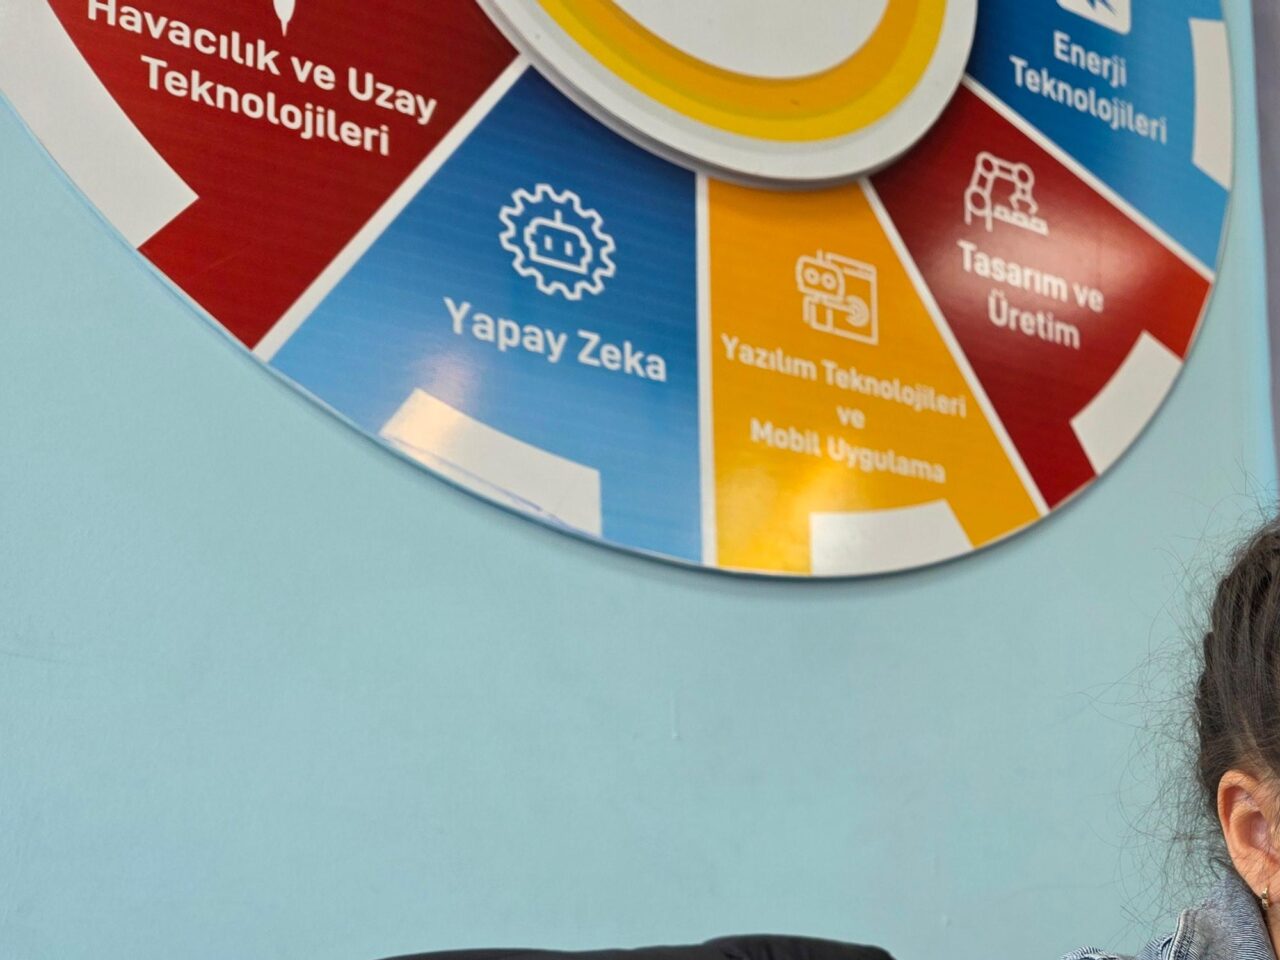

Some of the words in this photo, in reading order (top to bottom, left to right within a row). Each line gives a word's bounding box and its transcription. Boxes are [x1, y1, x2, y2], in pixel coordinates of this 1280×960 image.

[87, 0, 280, 76] Havacılık
[291, 57, 335, 91] ve
[348, 66, 438, 125] Uzay
[1010, 55, 1168, 145] Teknolojileri
[1053, 31, 1128, 89] Enerji
[140, 54, 390, 156] Teknolojileri
[957, 240, 1068, 304] Tasarım
[1073, 282, 1105, 314] ve
[443, 296, 567, 364] Yapay
[578, 329, 667, 383] Zeka
[988, 288, 1080, 351] Üretim
[721, 333, 818, 382] Yazılım
[822, 363, 967, 419] Teknolojileri
[751, 418, 823, 458] Mobil
[827, 440, 947, 486] Uygulama
[836, 407, 865, 430] ve
